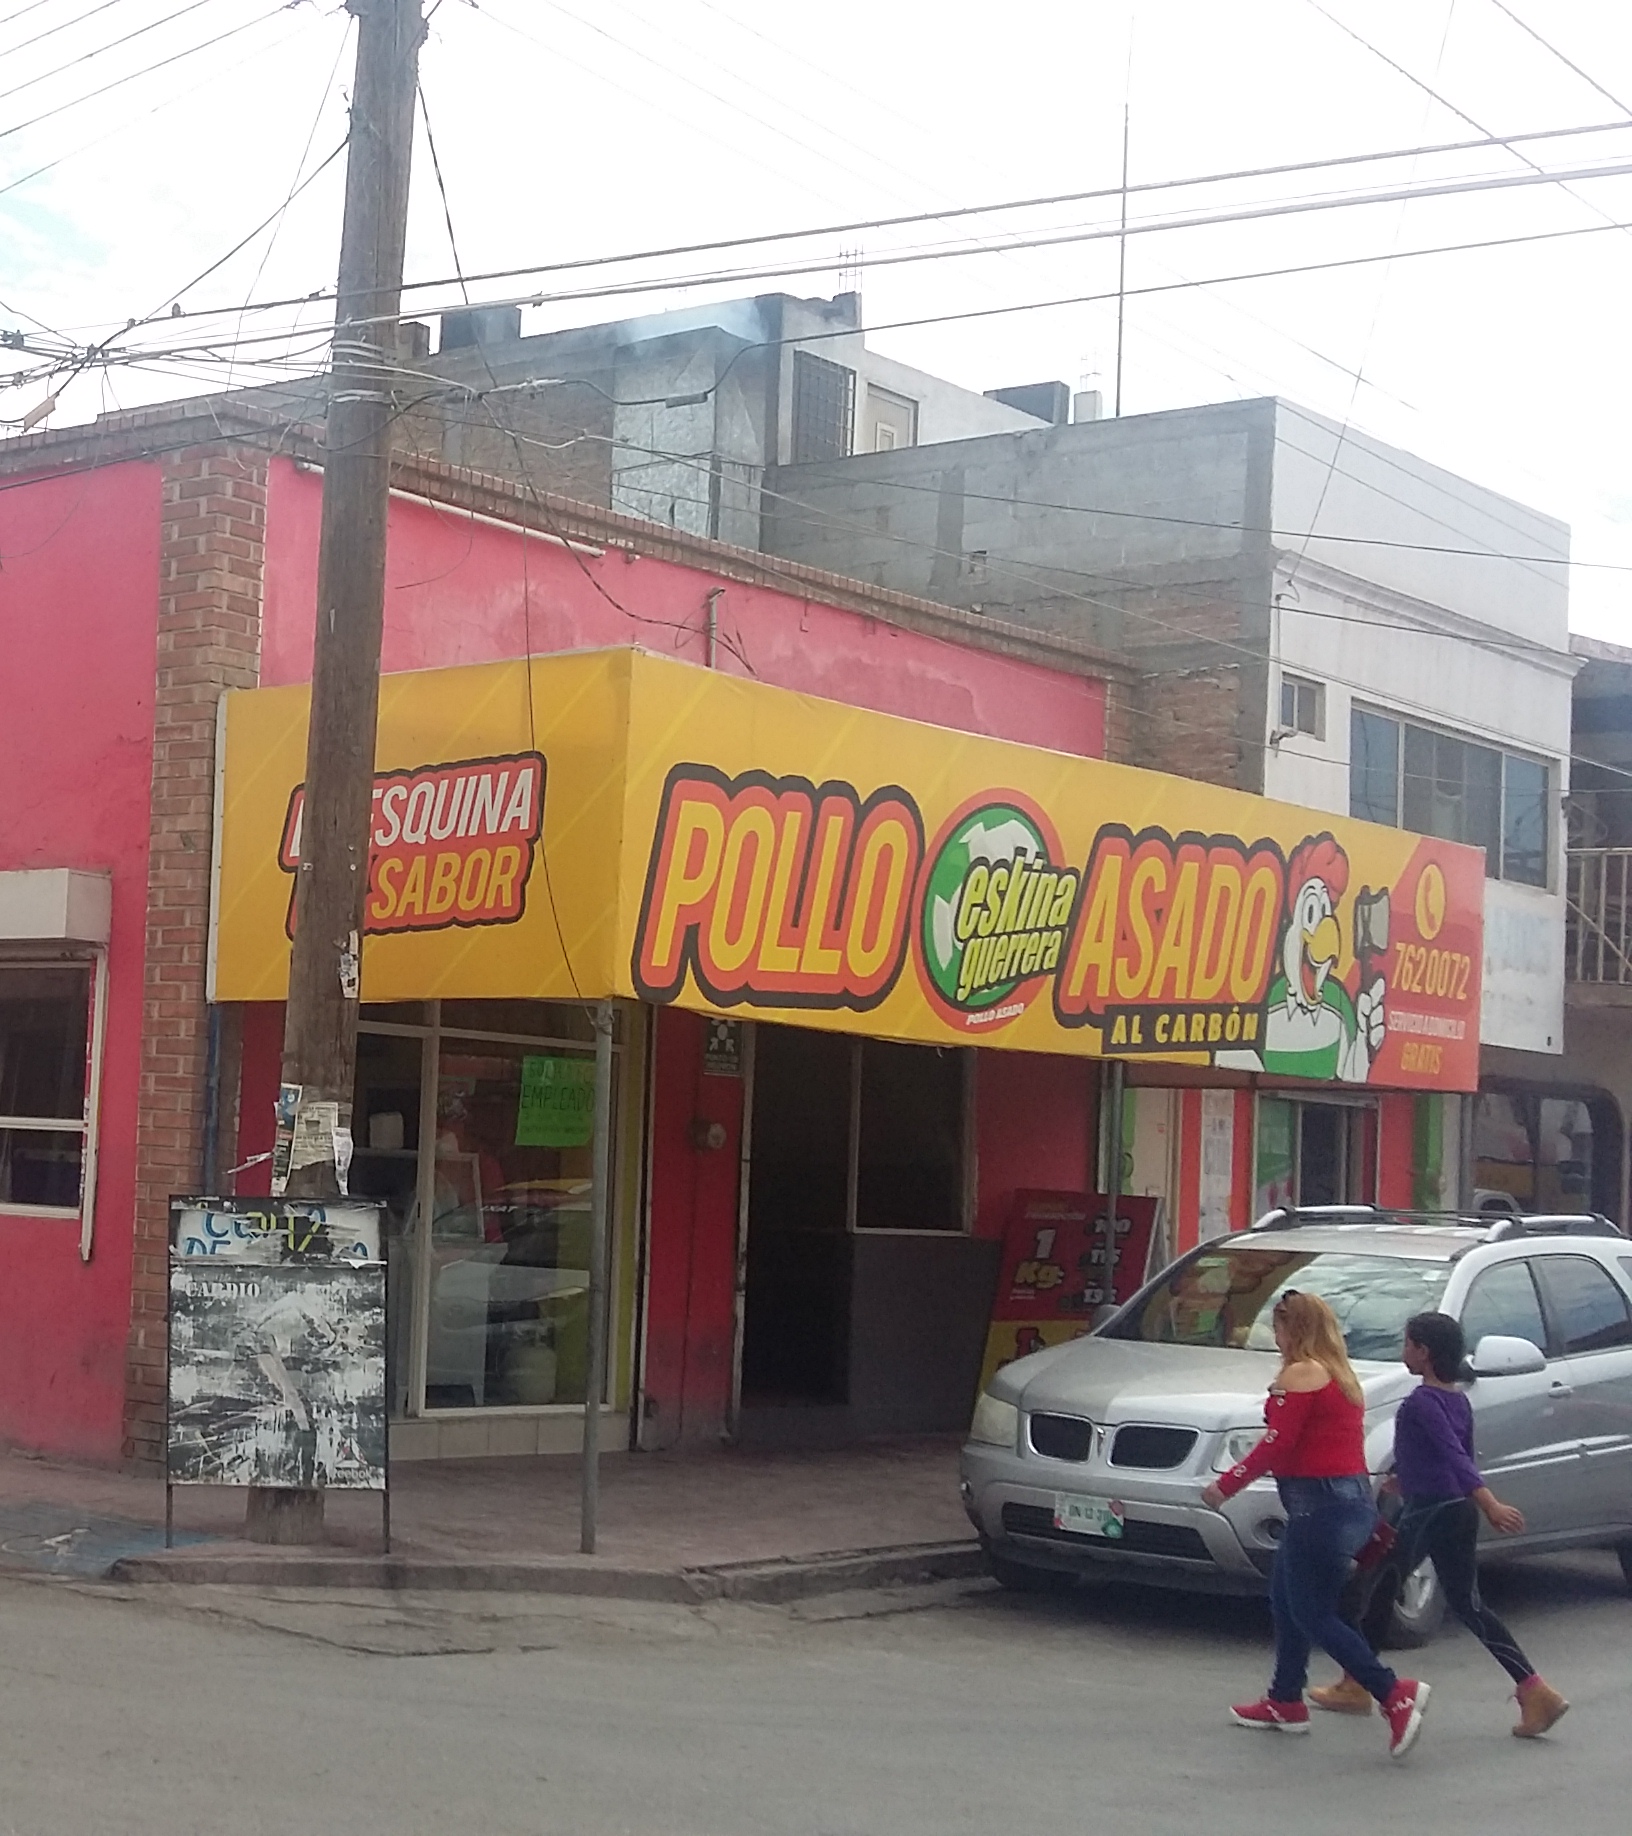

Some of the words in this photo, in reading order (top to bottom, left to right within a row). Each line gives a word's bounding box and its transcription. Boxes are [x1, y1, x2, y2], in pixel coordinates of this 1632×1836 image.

[369, 768, 533, 848] SQUINA
[371, 846, 521, 919] SABOR
[651, 800, 908, 978] POLLO
[1069, 854, 1277, 1003] ASADO
[957, 855, 1077, 940] eskina
[957, 930, 1062, 1001] guerrera
[1110, 1014, 1143, 1044] AL
[1154, 1005, 1258, 1043] CARBÓN
